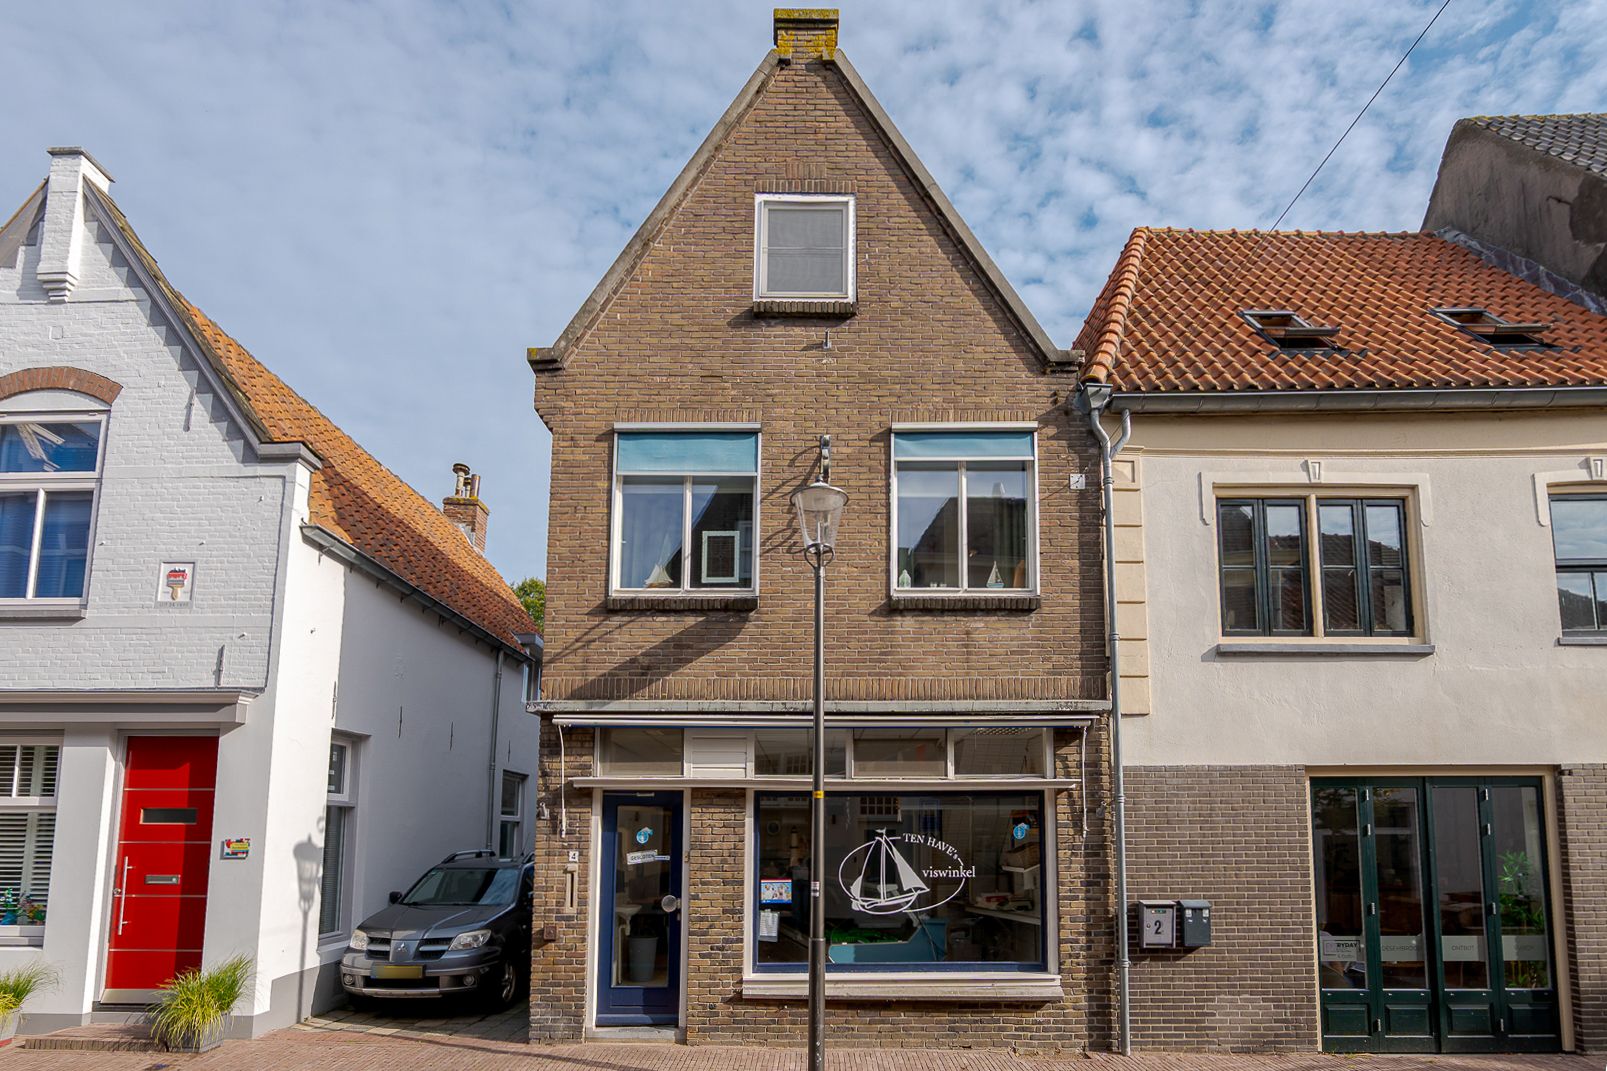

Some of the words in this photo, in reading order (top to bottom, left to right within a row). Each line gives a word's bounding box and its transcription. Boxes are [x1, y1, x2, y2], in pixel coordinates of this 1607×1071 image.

[903, 833, 925, 843] TEN
[922, 866, 976, 878] viswinkel
[1154, 920, 1162, 935] 2
